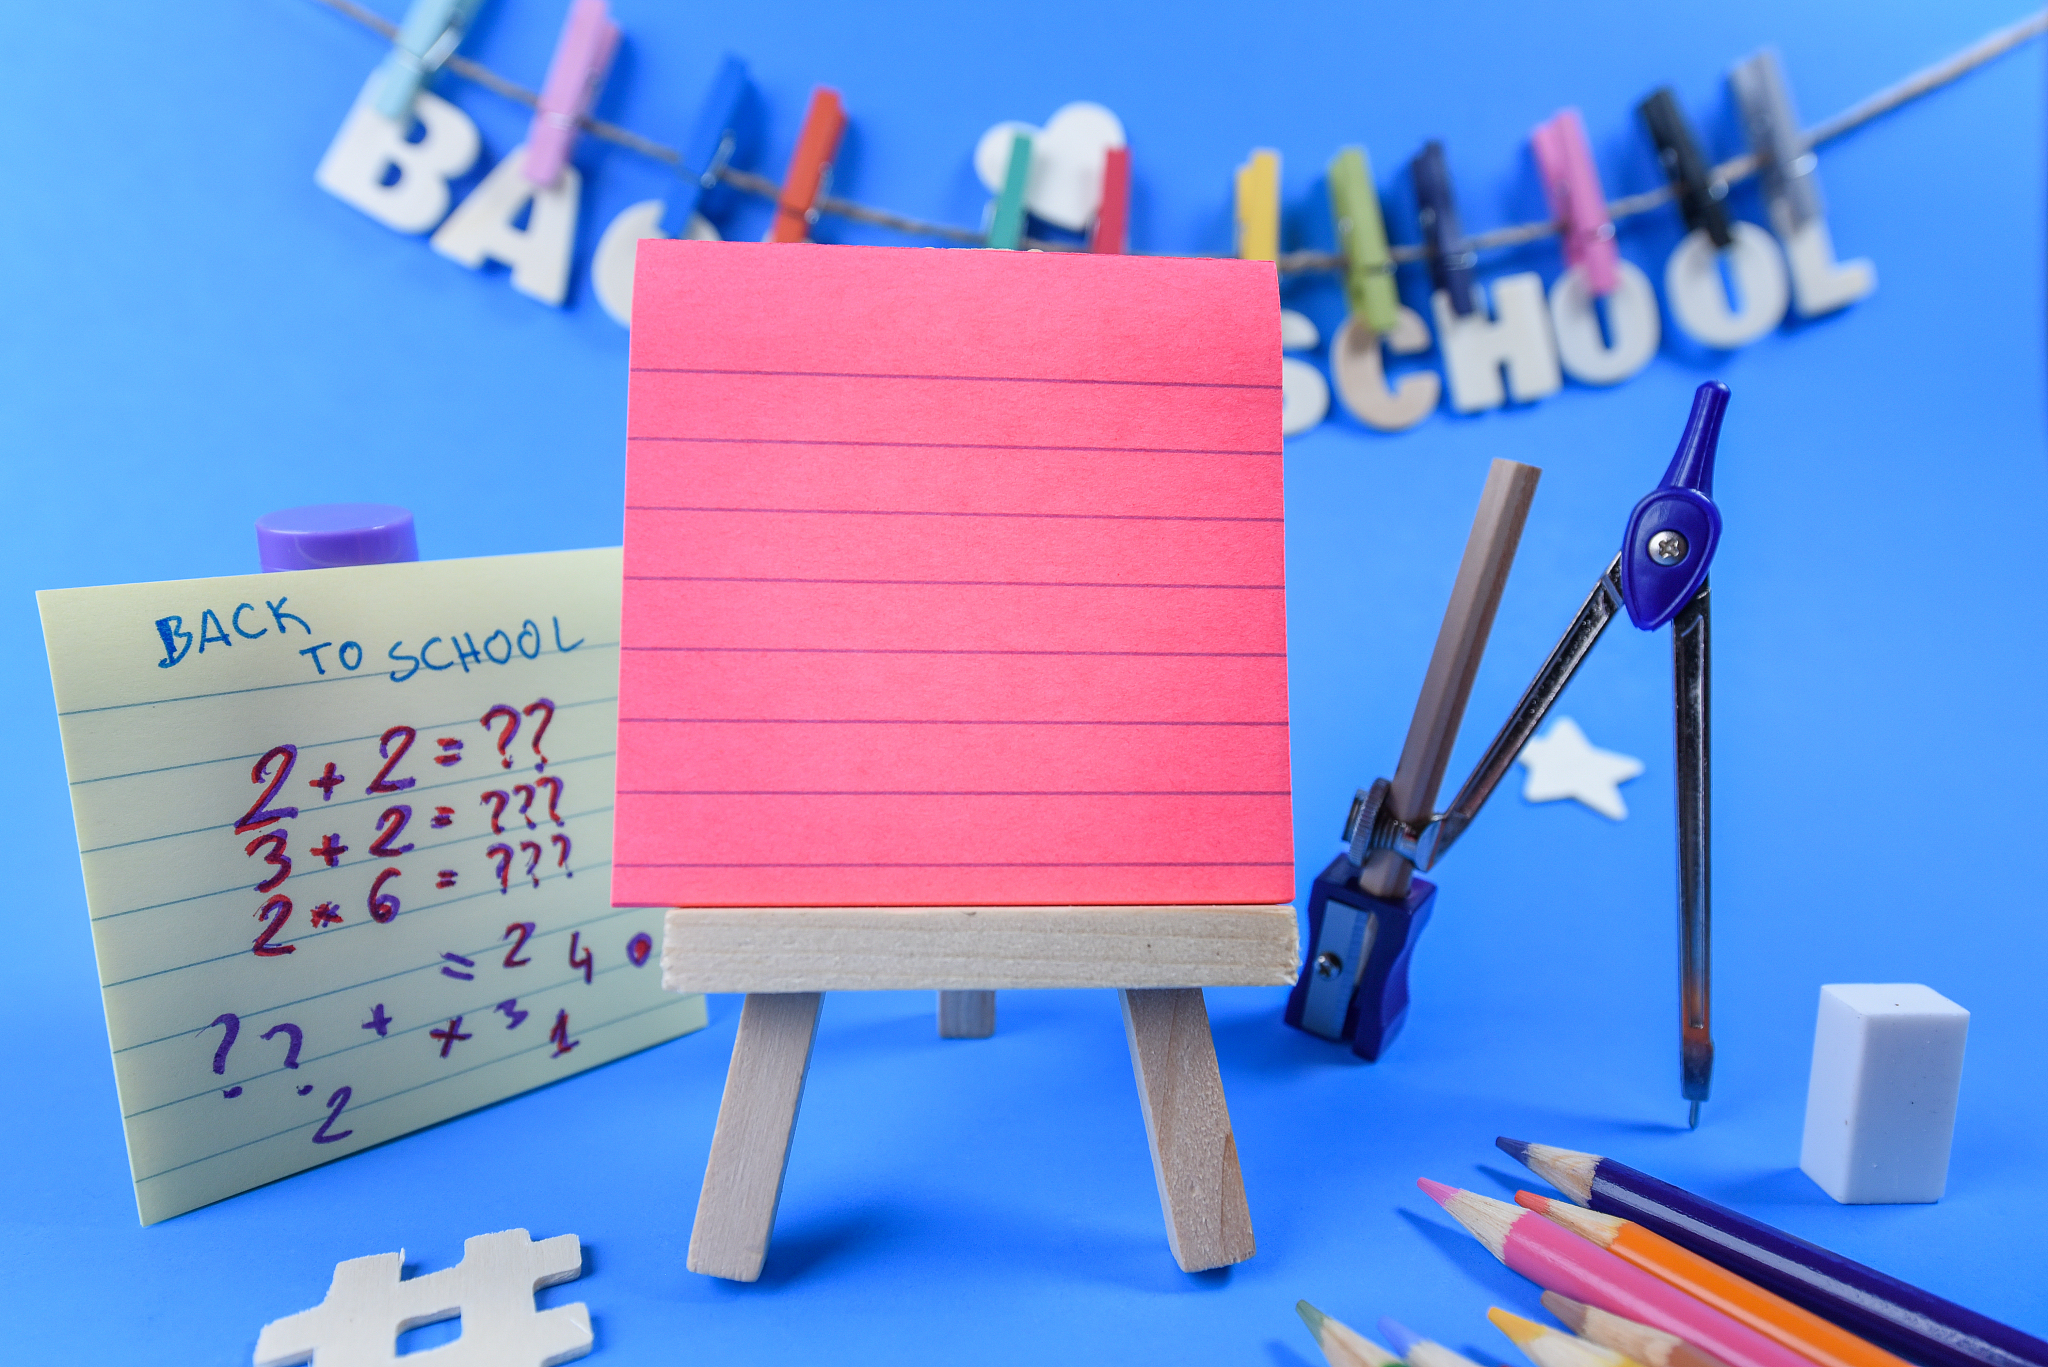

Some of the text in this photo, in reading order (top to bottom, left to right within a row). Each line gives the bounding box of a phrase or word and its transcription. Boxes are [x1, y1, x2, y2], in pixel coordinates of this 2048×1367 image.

[155, 597, 311, 668] BACK
[299, 617, 584, 682] TO SCHOOL
[234, 697, 557, 835] 2 + 2 = ??
[245, 776, 565, 893] 3 + 2 = ???
[252, 894, 297, 957] 2
[367, 867, 401, 924] 6
[435, 870, 458, 890] =
[486, 833, 574, 895] ???
[503, 922, 536, 969] 2
[312, 1086, 353, 1144] 2
